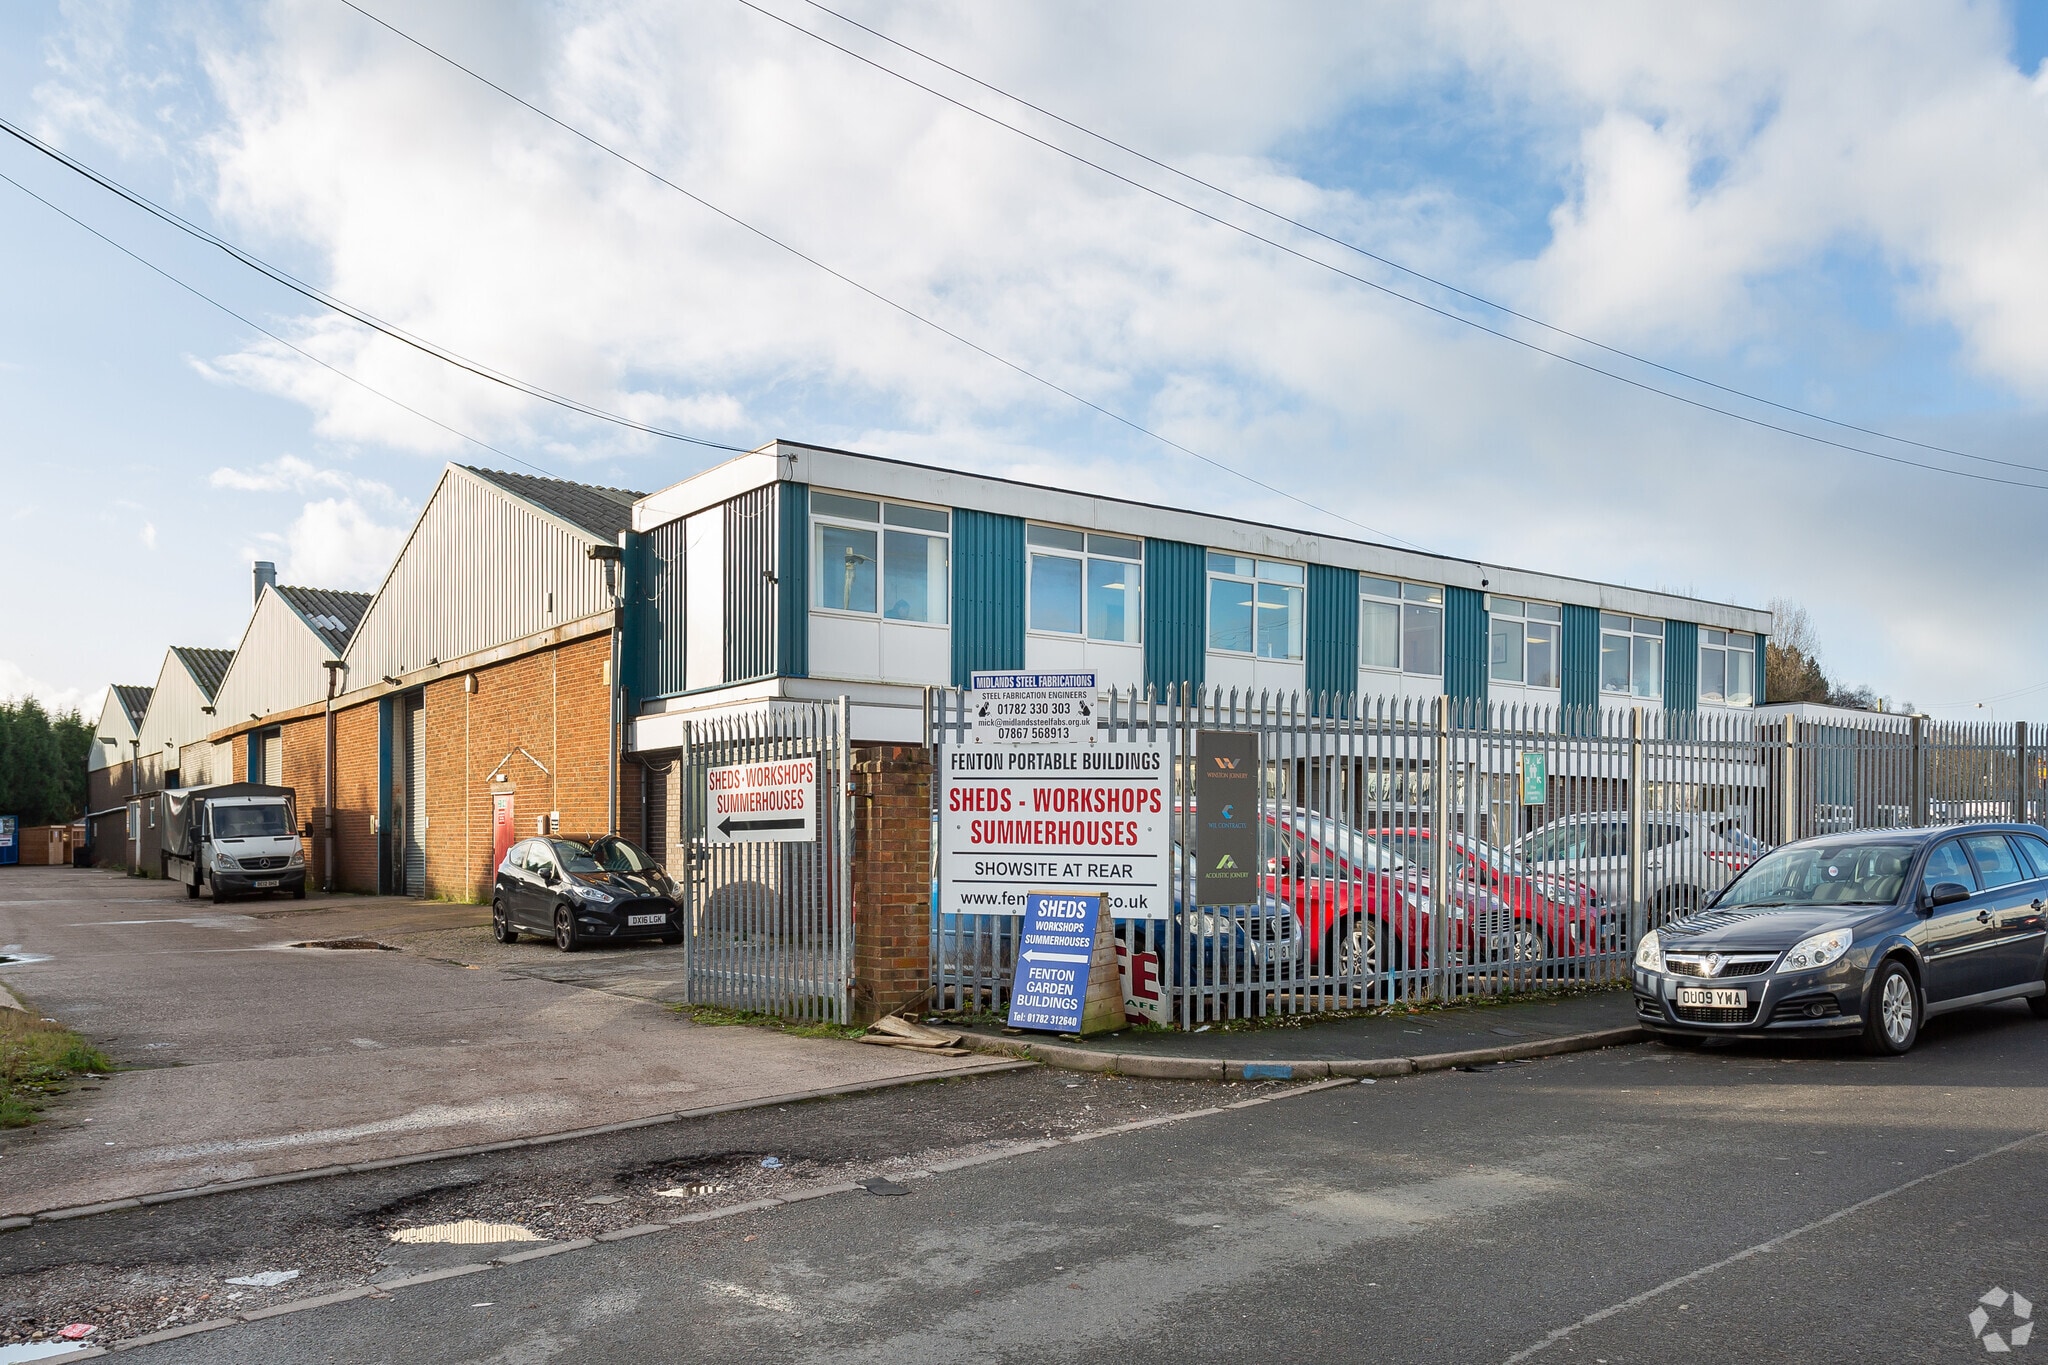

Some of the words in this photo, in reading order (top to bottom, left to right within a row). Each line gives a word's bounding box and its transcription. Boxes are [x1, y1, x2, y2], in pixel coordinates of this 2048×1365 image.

[976, 676, 1015, 688] MIDLANDS
[1015, 675, 1037, 688] STEEL
[1038, 674, 1092, 687] FABRICATIONS
[982, 692, 1001, 700] STEEL
[1002, 691, 1047, 700] FABRICATION
[1048, 691, 1087, 699] ENGINEERS
[997, 703, 1027, 715] 01782
[1029, 703, 1049, 714] 330
[1051, 702, 1071, 714] 303
[978, 717, 1091, 728] mick@midlandssteelfabs.org.uk
[998, 727, 1029, 739] 07867
[1031, 727, 1070, 739] 568913
[951, 752, 1004, 771] FENTON
[1008, 752, 1078, 771] PORTABLE
[1082, 752, 1161, 771] BUILDINGS
[709, 769, 740, 791] SHEDS
[745, 762, 813, 787] WORKSHOPS
[717, 789, 804, 813] SUMMERHOUSES
[949, 787, 1012, 812] SHEDS
[1032, 787, 1162, 813] WORKSHOPS
[970, 819, 1139, 847] SUMMERHOUSES
[974, 861, 1058, 877] SHOWSITE
[1062, 863, 1083, 878] AT
[1087, 864, 1134, 878] REAR
[1037, 899, 1087, 919] SHEDS
[632, 916, 648, 924] DX16
[650, 915, 662, 923] LGK
[1035, 920, 1085, 933] WORKSHOPS
[1024, 934, 1091, 948] SUMMERHOUSES
[1028, 967, 1075, 982] FENTON
[1026, 981, 1074, 996] GARDEN
[1016, 994, 1078, 1011] BUILDINGS
[1716, 991, 1741, 1005] YWA
[1013, 1011, 1026, 1023] Tel:
[1027, 1012, 1049, 1025] 01782
[1050, 1014, 1077, 1027] 312640
